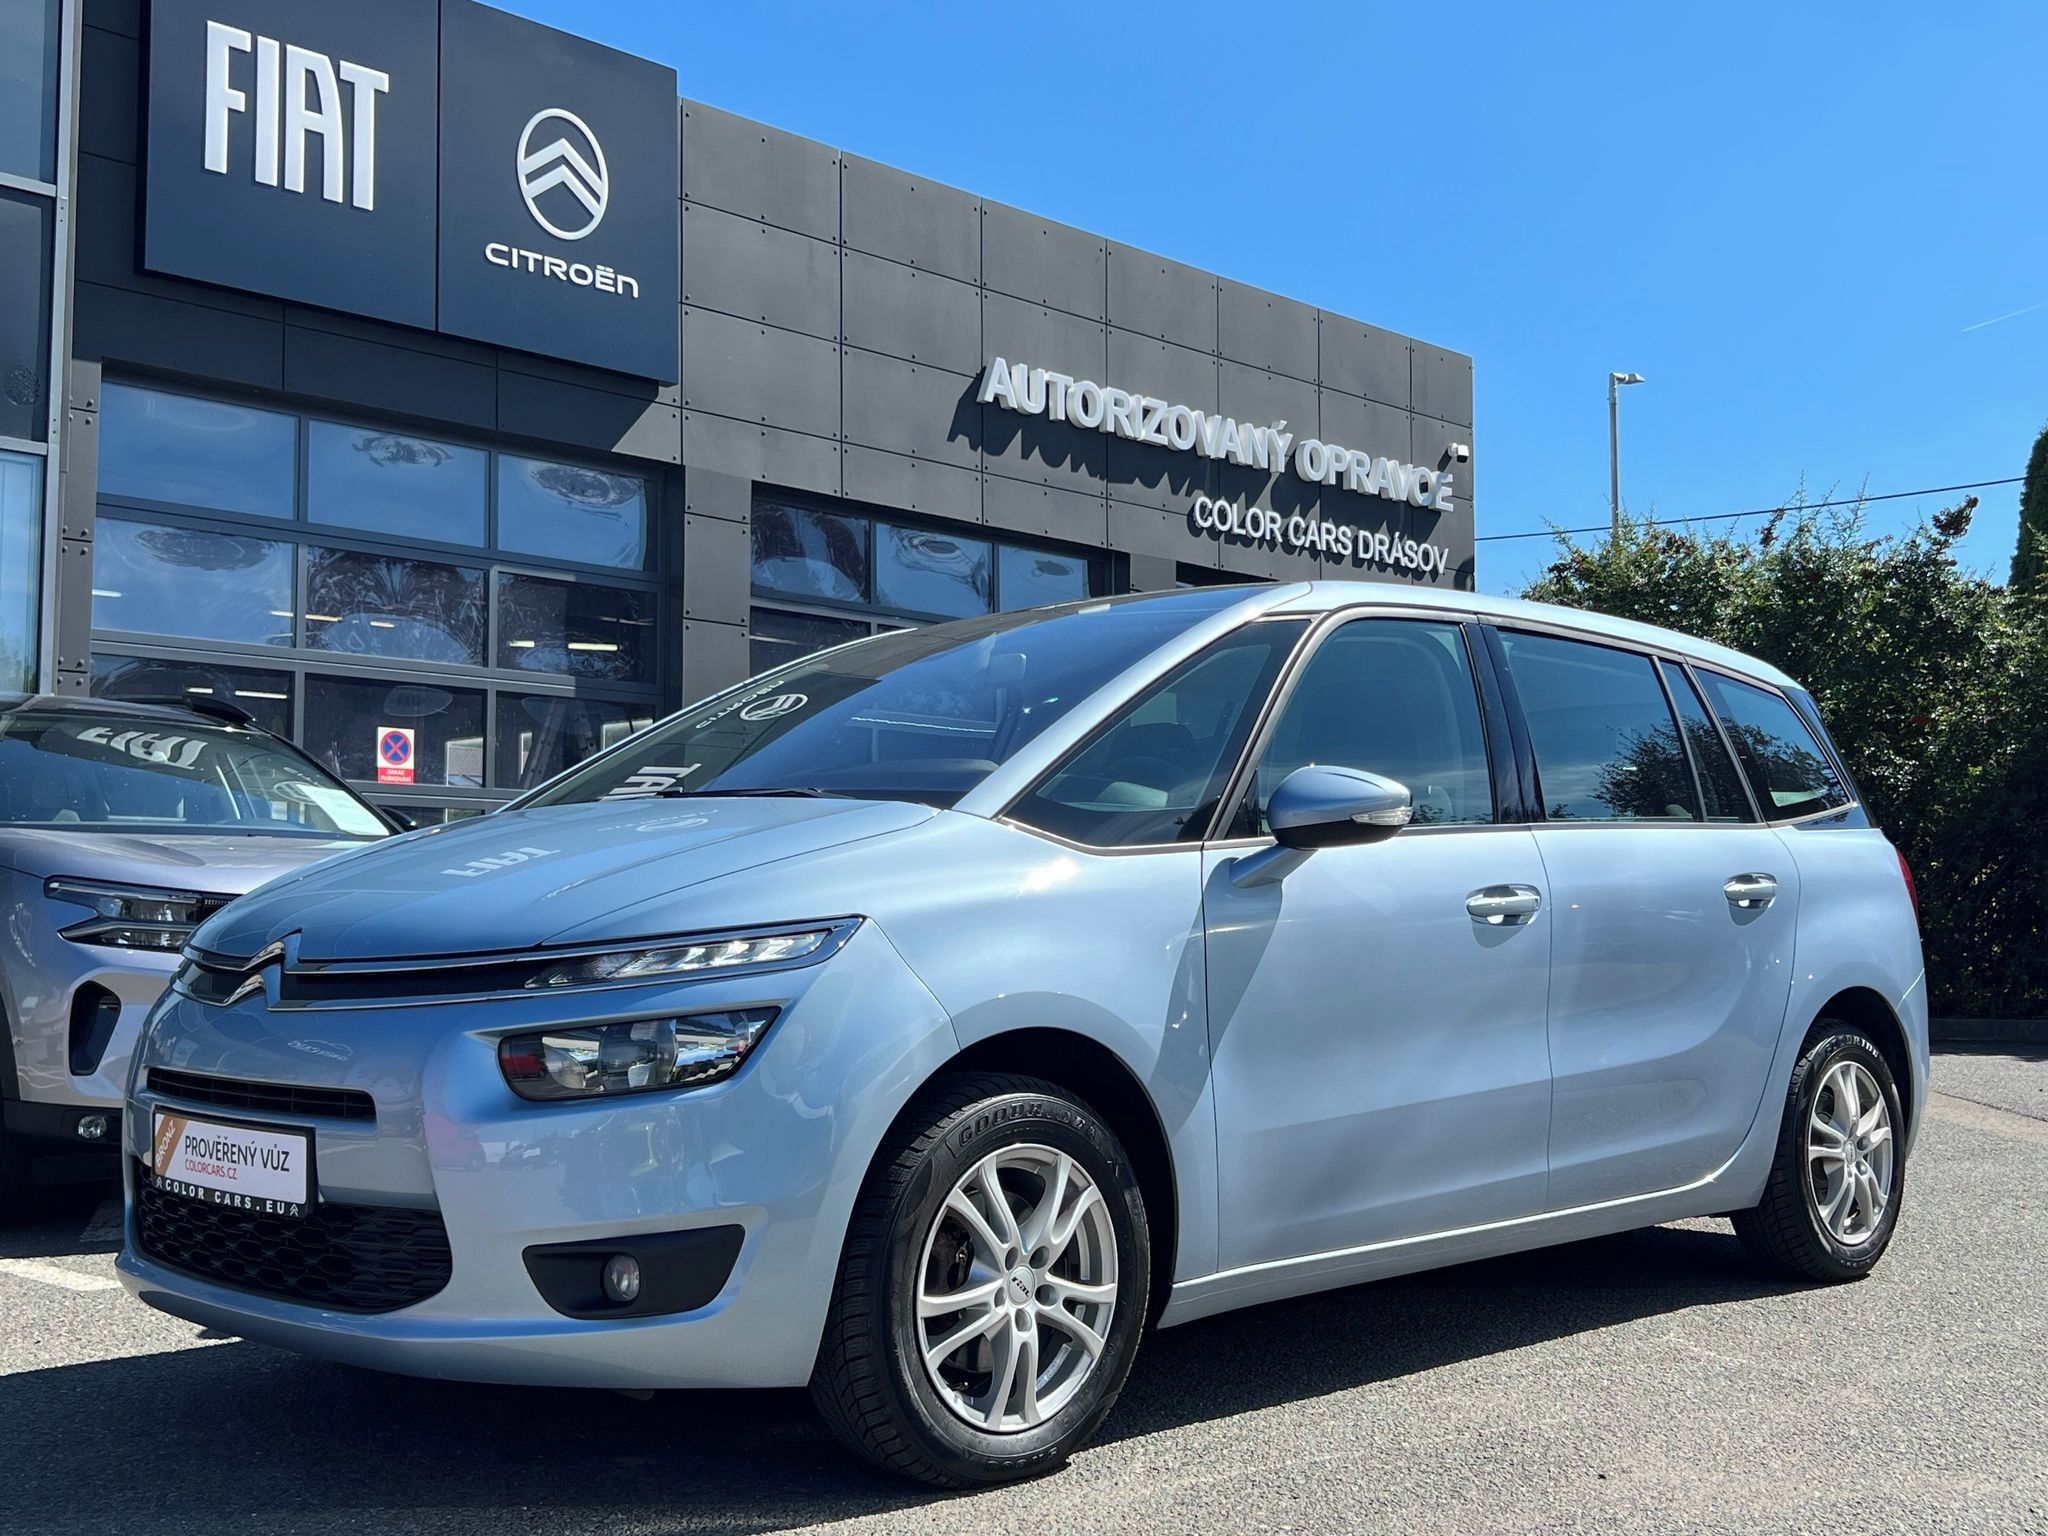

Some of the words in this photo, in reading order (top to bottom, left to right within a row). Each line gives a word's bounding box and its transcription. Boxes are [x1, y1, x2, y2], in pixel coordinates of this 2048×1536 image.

[205, 20, 390, 211] FIAT
[976, 356, 1293, 474] AUTORIZOVANÝ
[1295, 438, 1454, 513] OPRAVCE
[1194, 496, 1283, 543] COLOR
[1288, 515, 1352, 556] CARS
[1357, 531, 1449, 575] DRÁSOV
[155, 1119, 176, 1168] BRONZ
[184, 1133, 257, 1168] PROVĚŘENÝ
[260, 1143, 290, 1173] VŮZ
[165, 1179, 205, 1200] COLOR
[184, 1158, 238, 1181] COLORCARS.CZ
